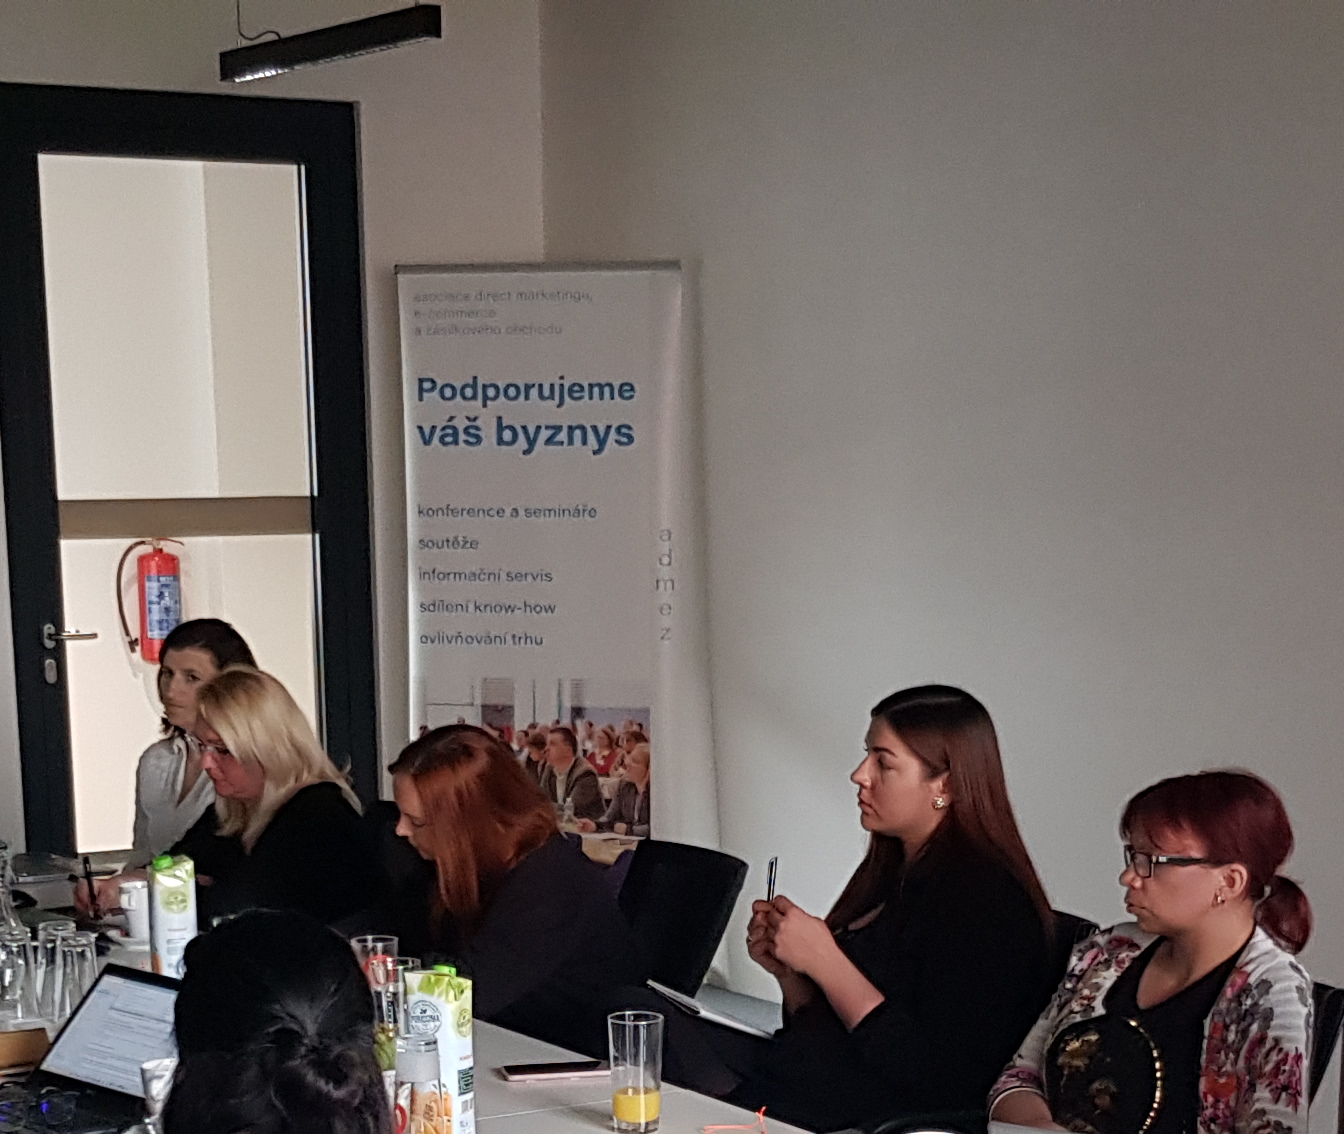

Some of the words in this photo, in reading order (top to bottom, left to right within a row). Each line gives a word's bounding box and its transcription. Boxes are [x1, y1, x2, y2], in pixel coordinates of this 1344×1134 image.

[416, 375, 636, 409] Podporujeme
[416, 414, 483, 447] váš
[495, 415, 635, 456] byznys
[417, 503, 506, 519] konference
[509, 506, 519, 519] a
[418, 566, 502, 583] informační
[505, 568, 554, 583] servis
[473, 600, 557, 615] know-how
[419, 630, 507, 646] ovlivňování
[510, 632, 544, 646] trhu
